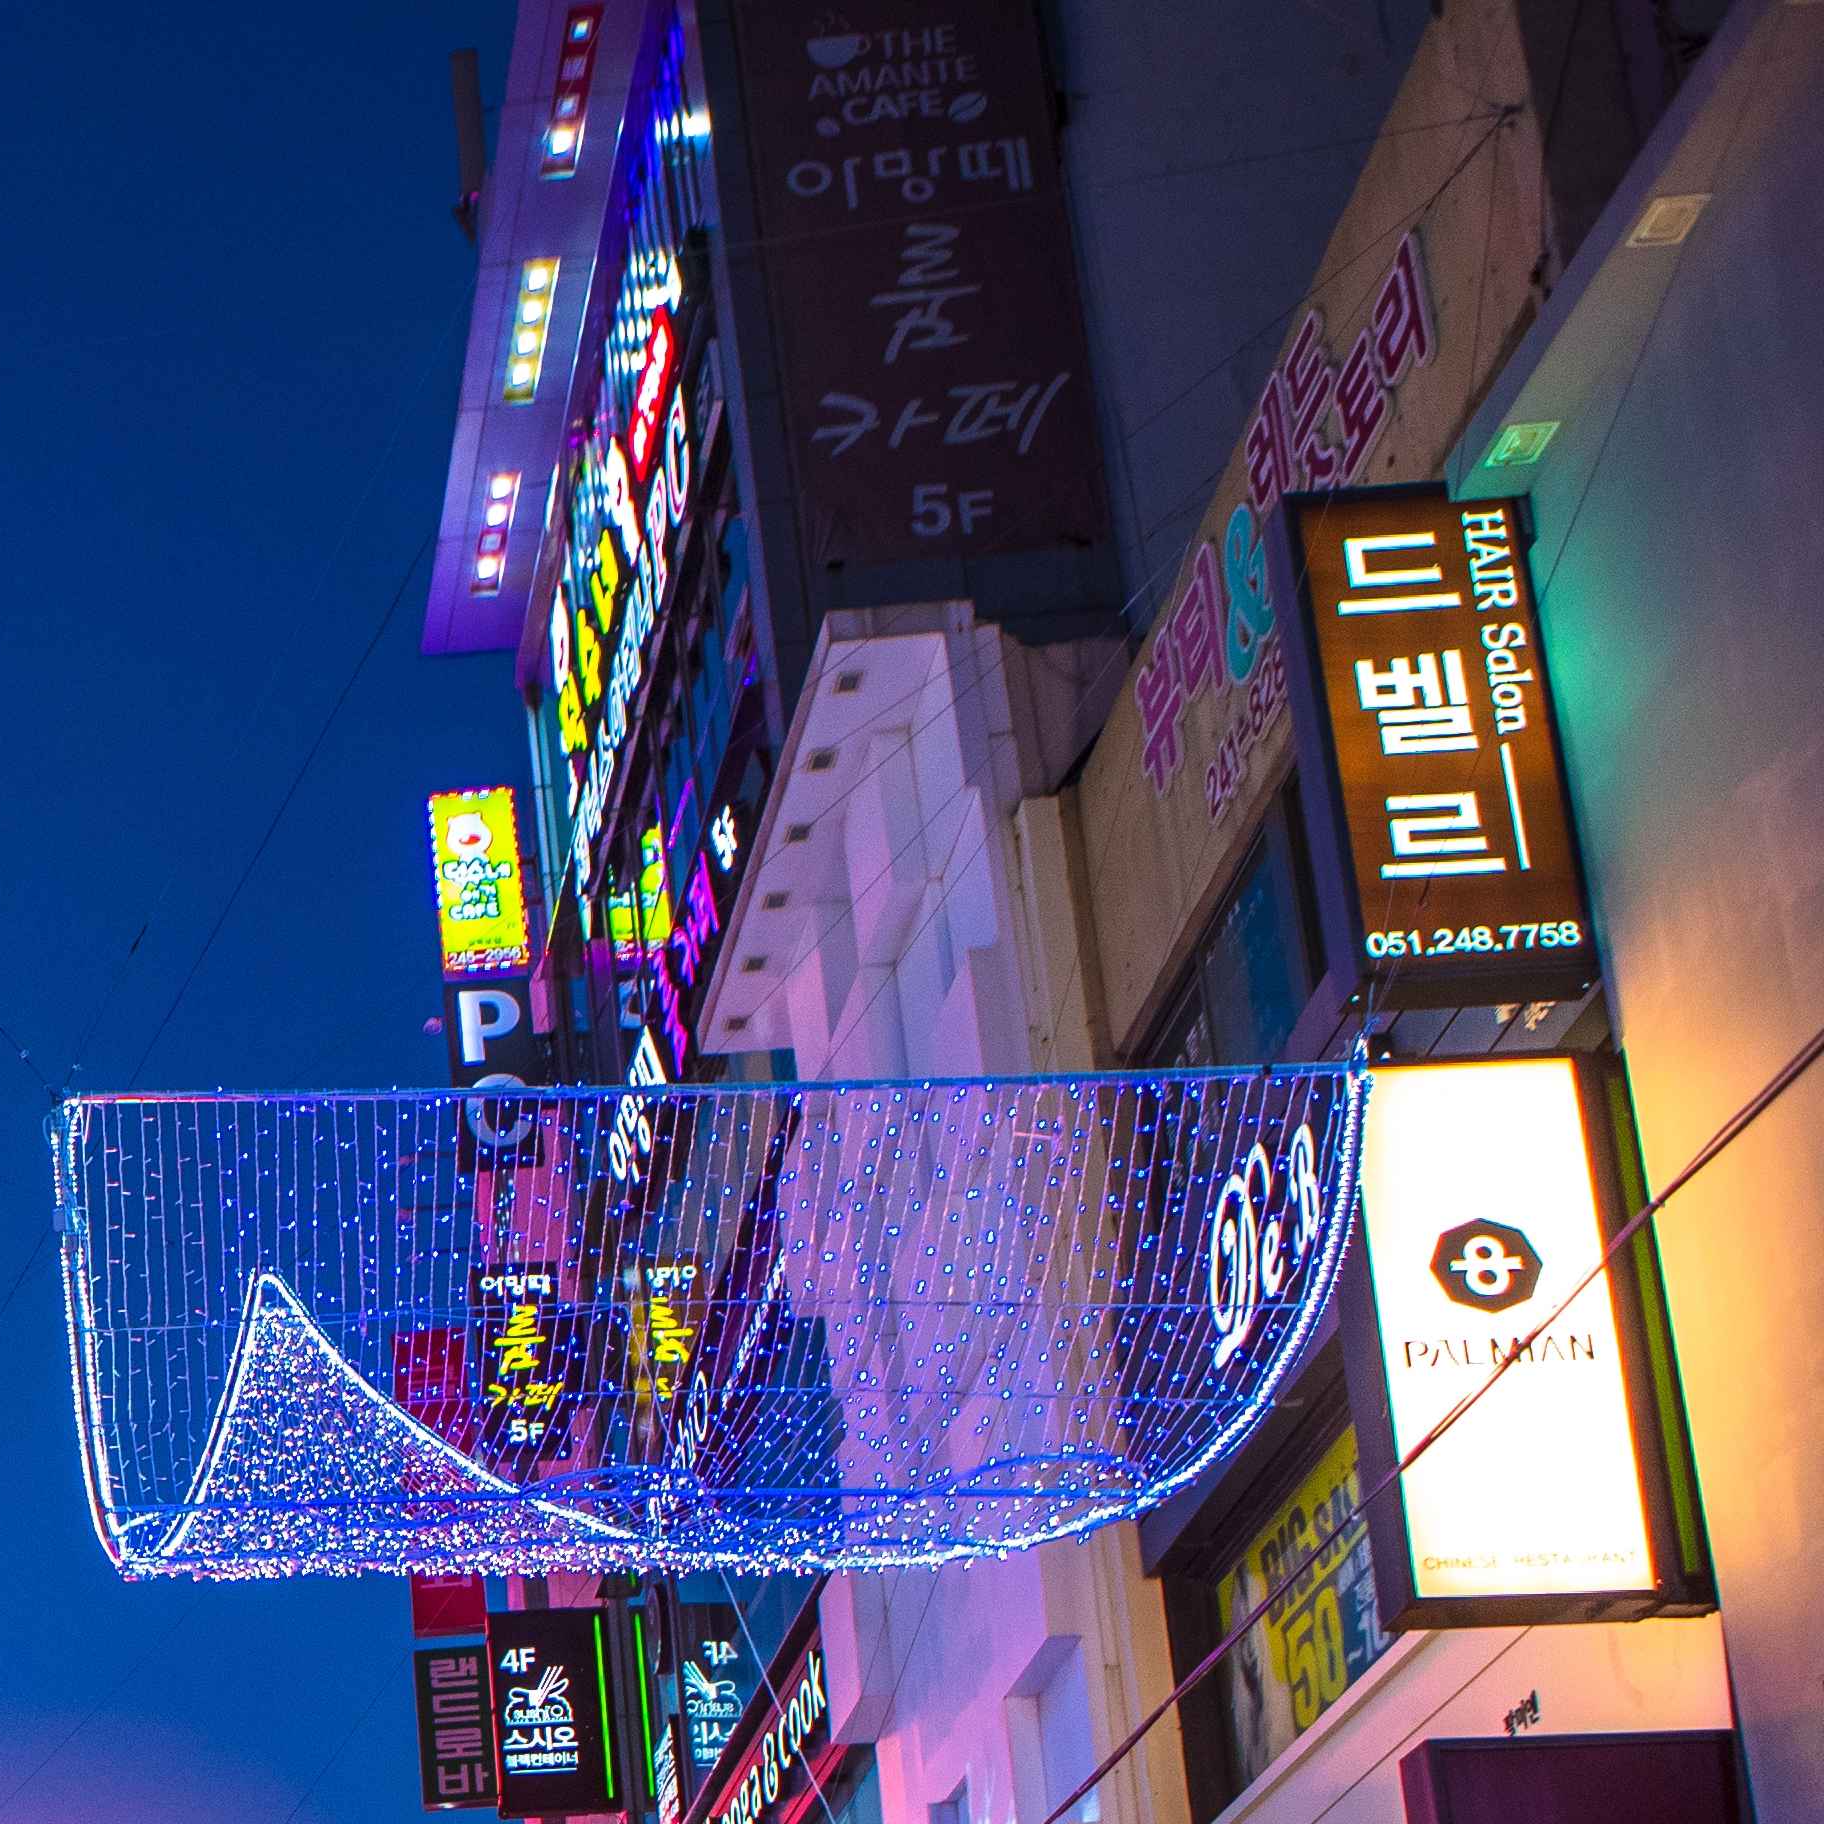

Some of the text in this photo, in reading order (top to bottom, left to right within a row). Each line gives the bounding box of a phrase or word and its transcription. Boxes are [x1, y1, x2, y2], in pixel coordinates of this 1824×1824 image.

[874, 26, 955, 56] THE
[809, 55, 977, 98] AMANTE
[842, 90, 945, 124] CAFE
[911, 486, 994, 536] 5F
[1461, 509, 1527, 734] HAIR Salon
[1366, 921, 1580, 958] 051.248.7758
[509, 1418, 544, 1442] 5F
[500, 1648, 536, 1673] 4F
[778, 1650, 827, 1769] cook
[503, 1726, 578, 1750] 스시오
